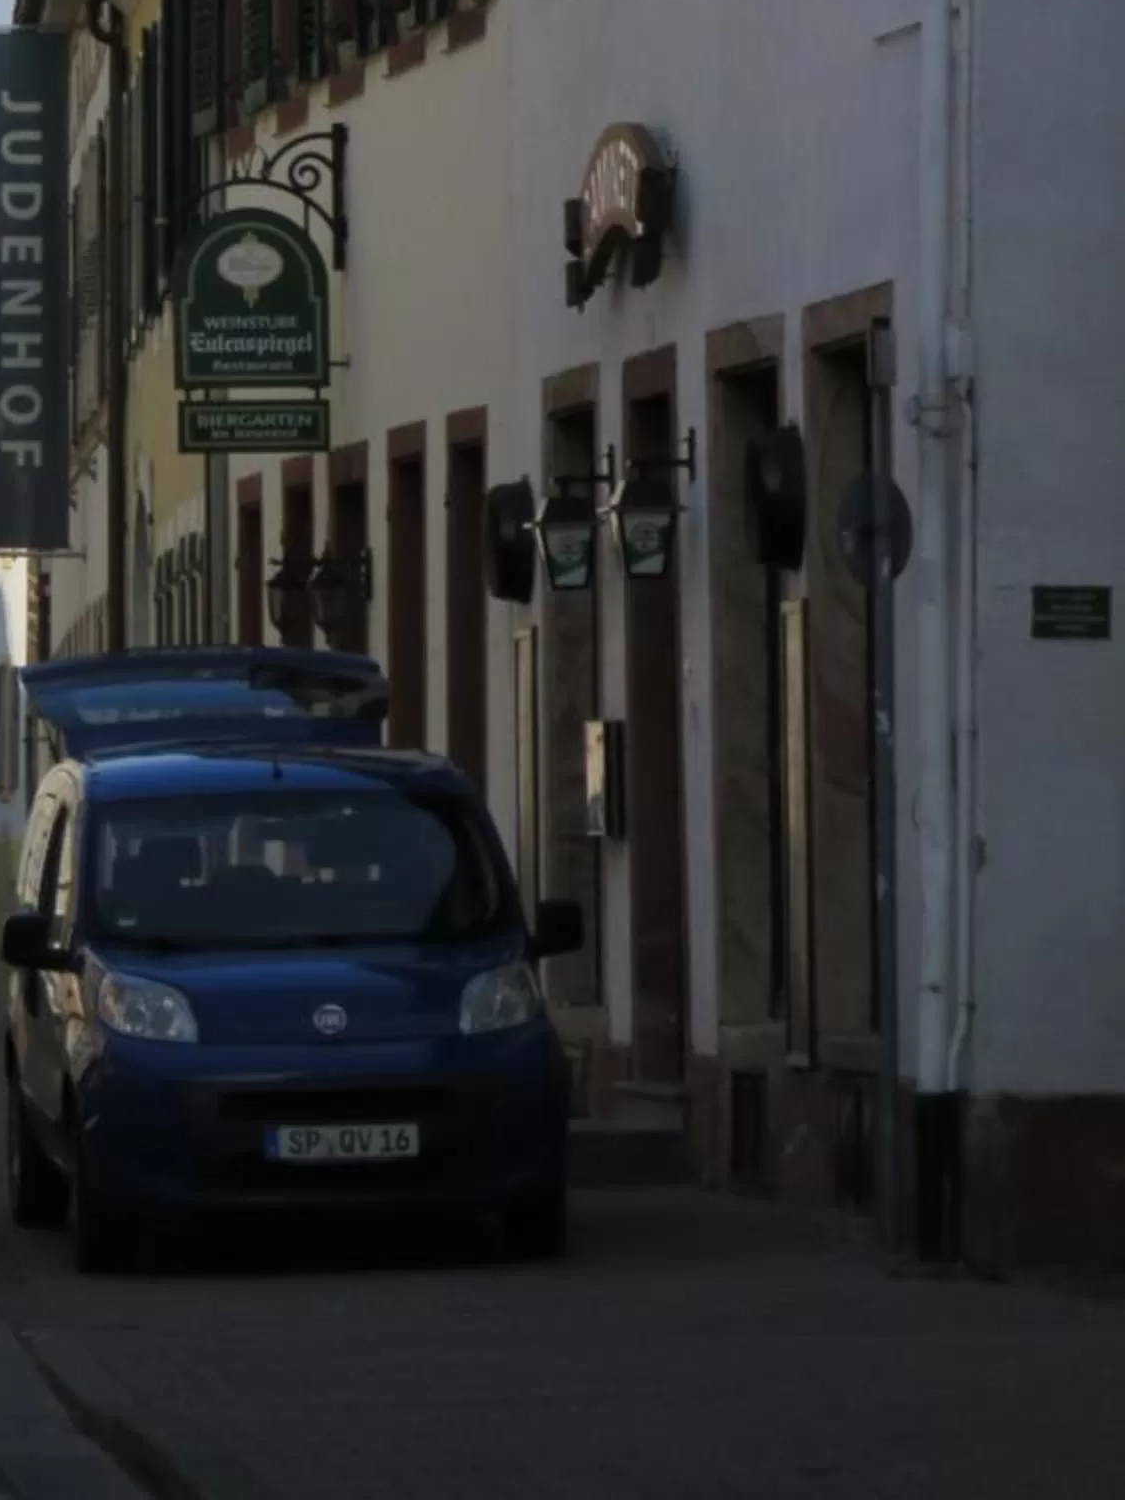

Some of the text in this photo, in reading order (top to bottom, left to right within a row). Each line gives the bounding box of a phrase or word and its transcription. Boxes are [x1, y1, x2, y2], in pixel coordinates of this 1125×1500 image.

[0, 90, 44, 469] JUDENHOF
[189, 331, 313, 356] Eulenspiegel
[196, 412, 313, 428] BIERGARTEN
[288, 1127, 411, 1155] SP QV 16
